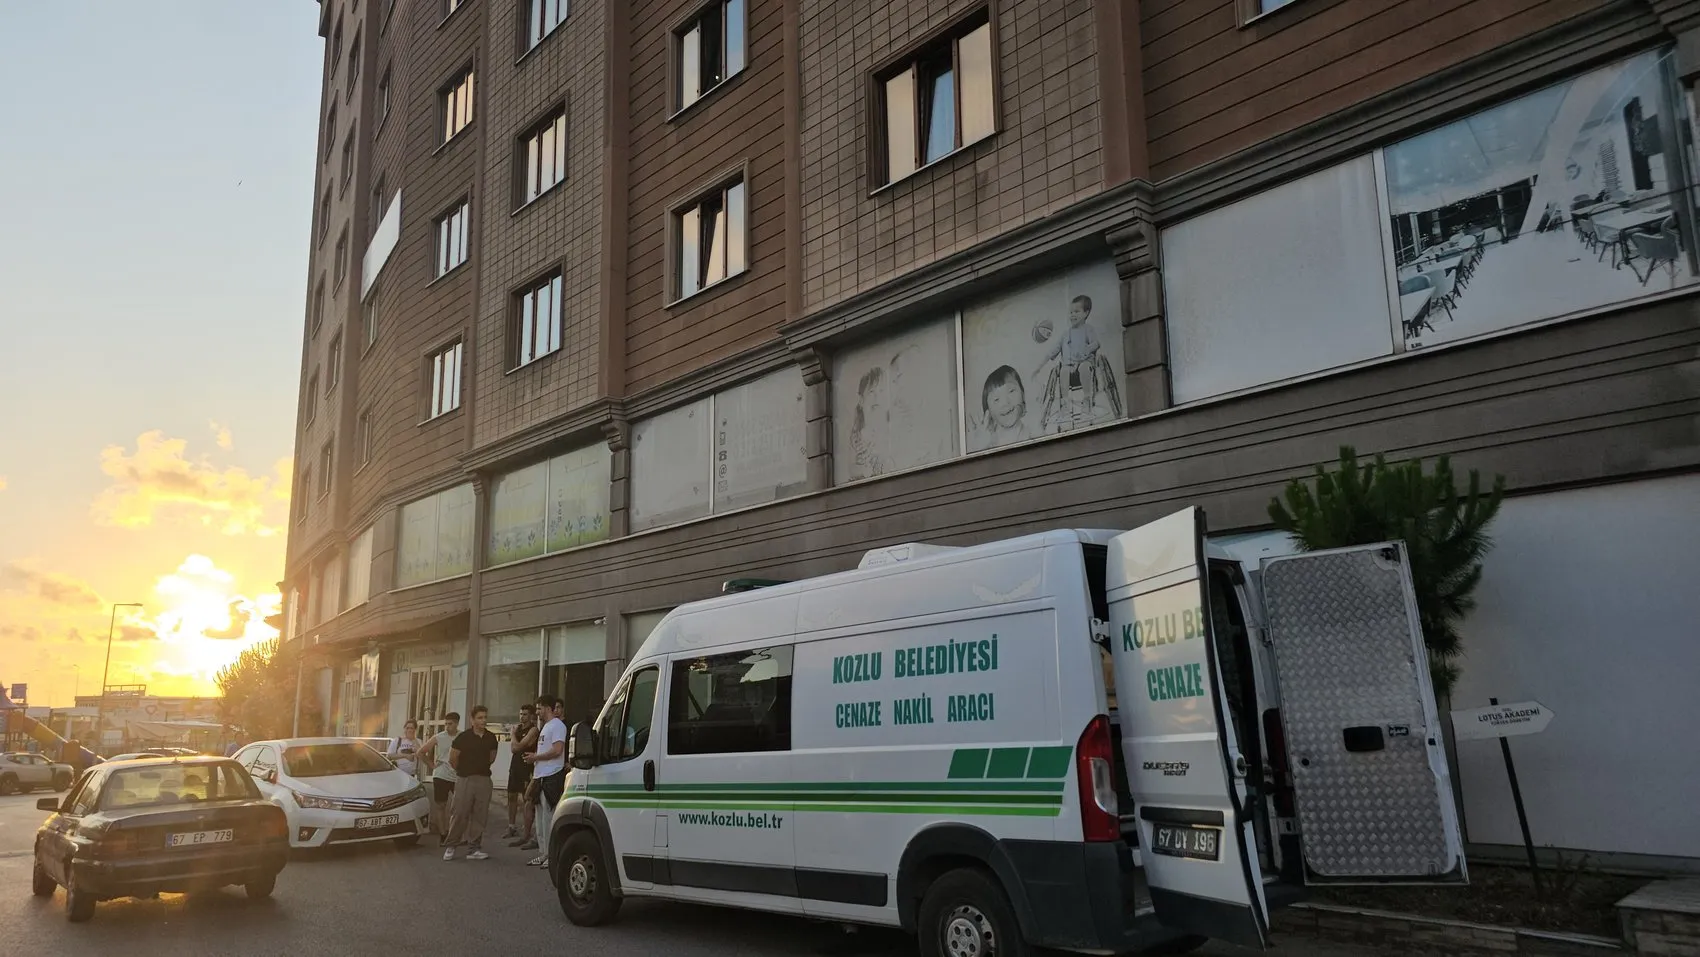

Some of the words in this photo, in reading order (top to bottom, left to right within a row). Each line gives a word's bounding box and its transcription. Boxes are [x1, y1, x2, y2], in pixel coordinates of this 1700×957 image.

[1122, 613, 1177, 652] KOZLU
[833, 652, 882, 684] KOZLU
[894, 634, 998, 678] BELEDİYESİ
[1146, 663, 1204, 702] CENAZE
[835, 701, 882, 729] CENAZE
[894, 692, 934, 725] NAKİL
[947, 692, 995, 722] ARACI
[1478, 713, 1503, 722] LOTUS
[1504, 707, 1540, 718] AKADEMİ
[678, 811, 783, 829] www.kozlu.bel.tr
[173, 835, 185, 844] 67
[193, 833, 206, 843] EP
[214, 830, 232, 841] 779
[1158, 828, 1172, 847] 67
[1193, 831, 1214, 853] 196
